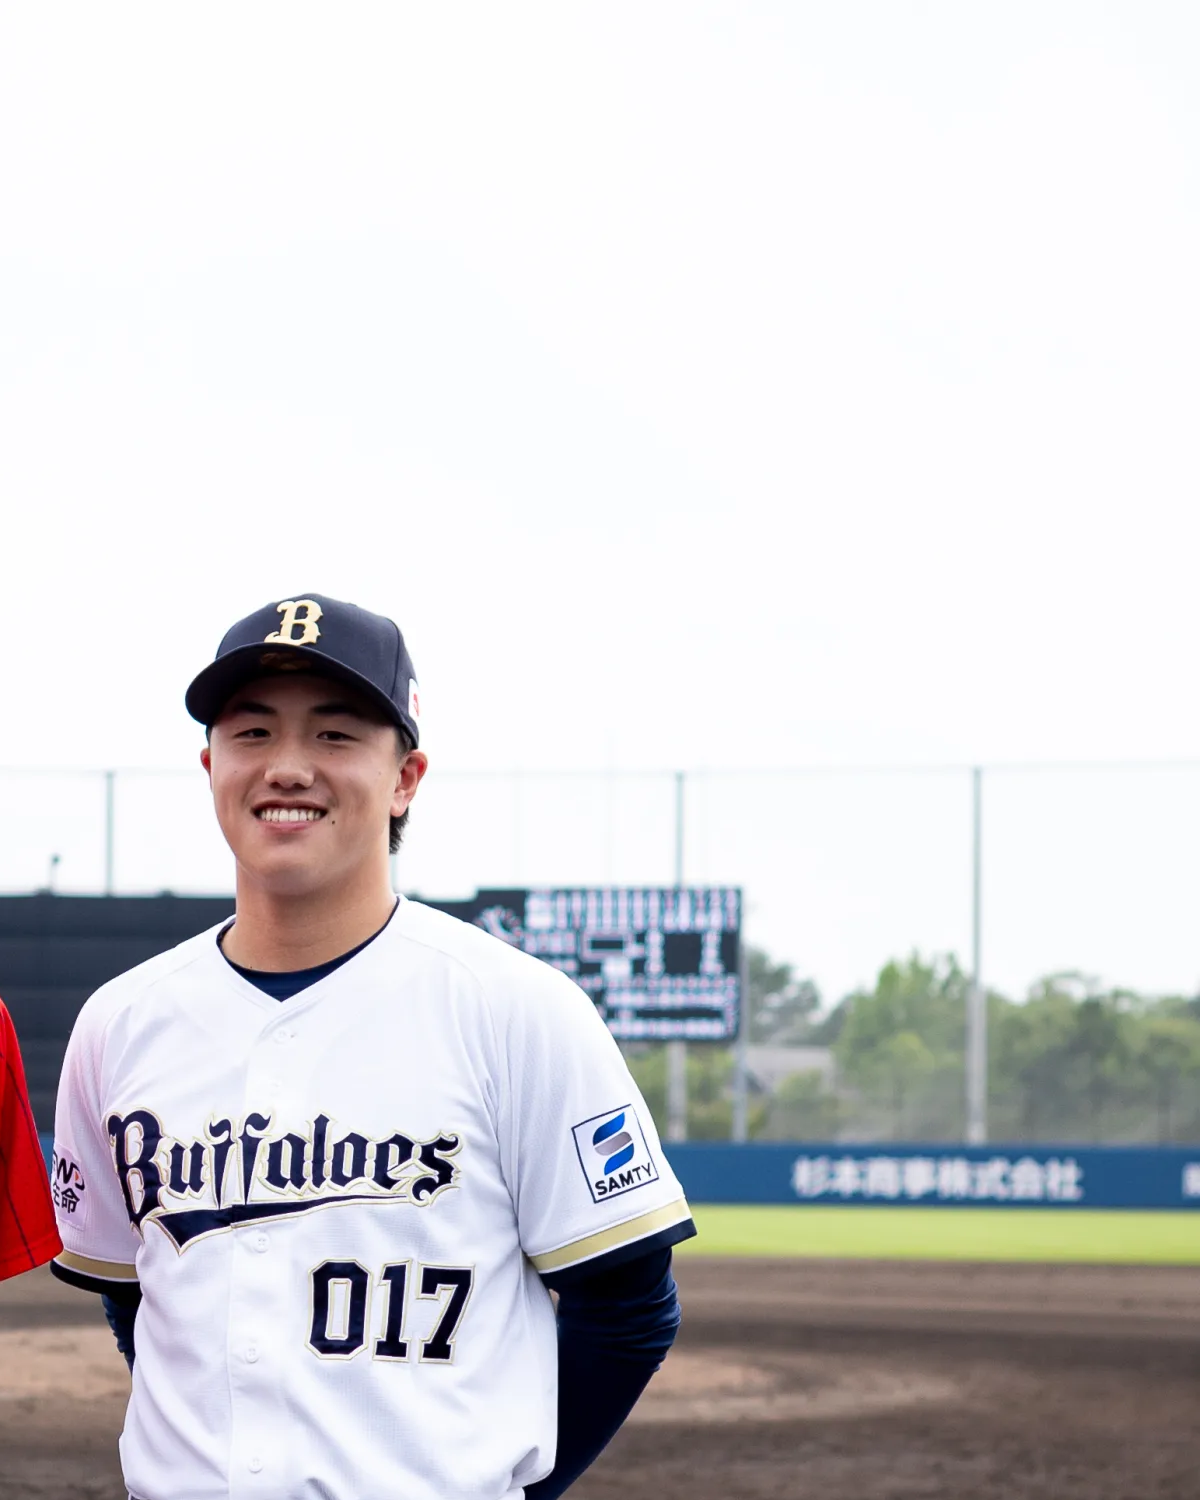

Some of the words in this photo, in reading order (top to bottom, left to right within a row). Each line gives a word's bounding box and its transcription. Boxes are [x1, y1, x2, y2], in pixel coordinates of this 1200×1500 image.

[264, 599, 324, 646] B
[105, 1107, 464, 1242] Buffaloes
[595, 1163, 653, 1196] SAMTY
[305, 1259, 476, 1364] 017
